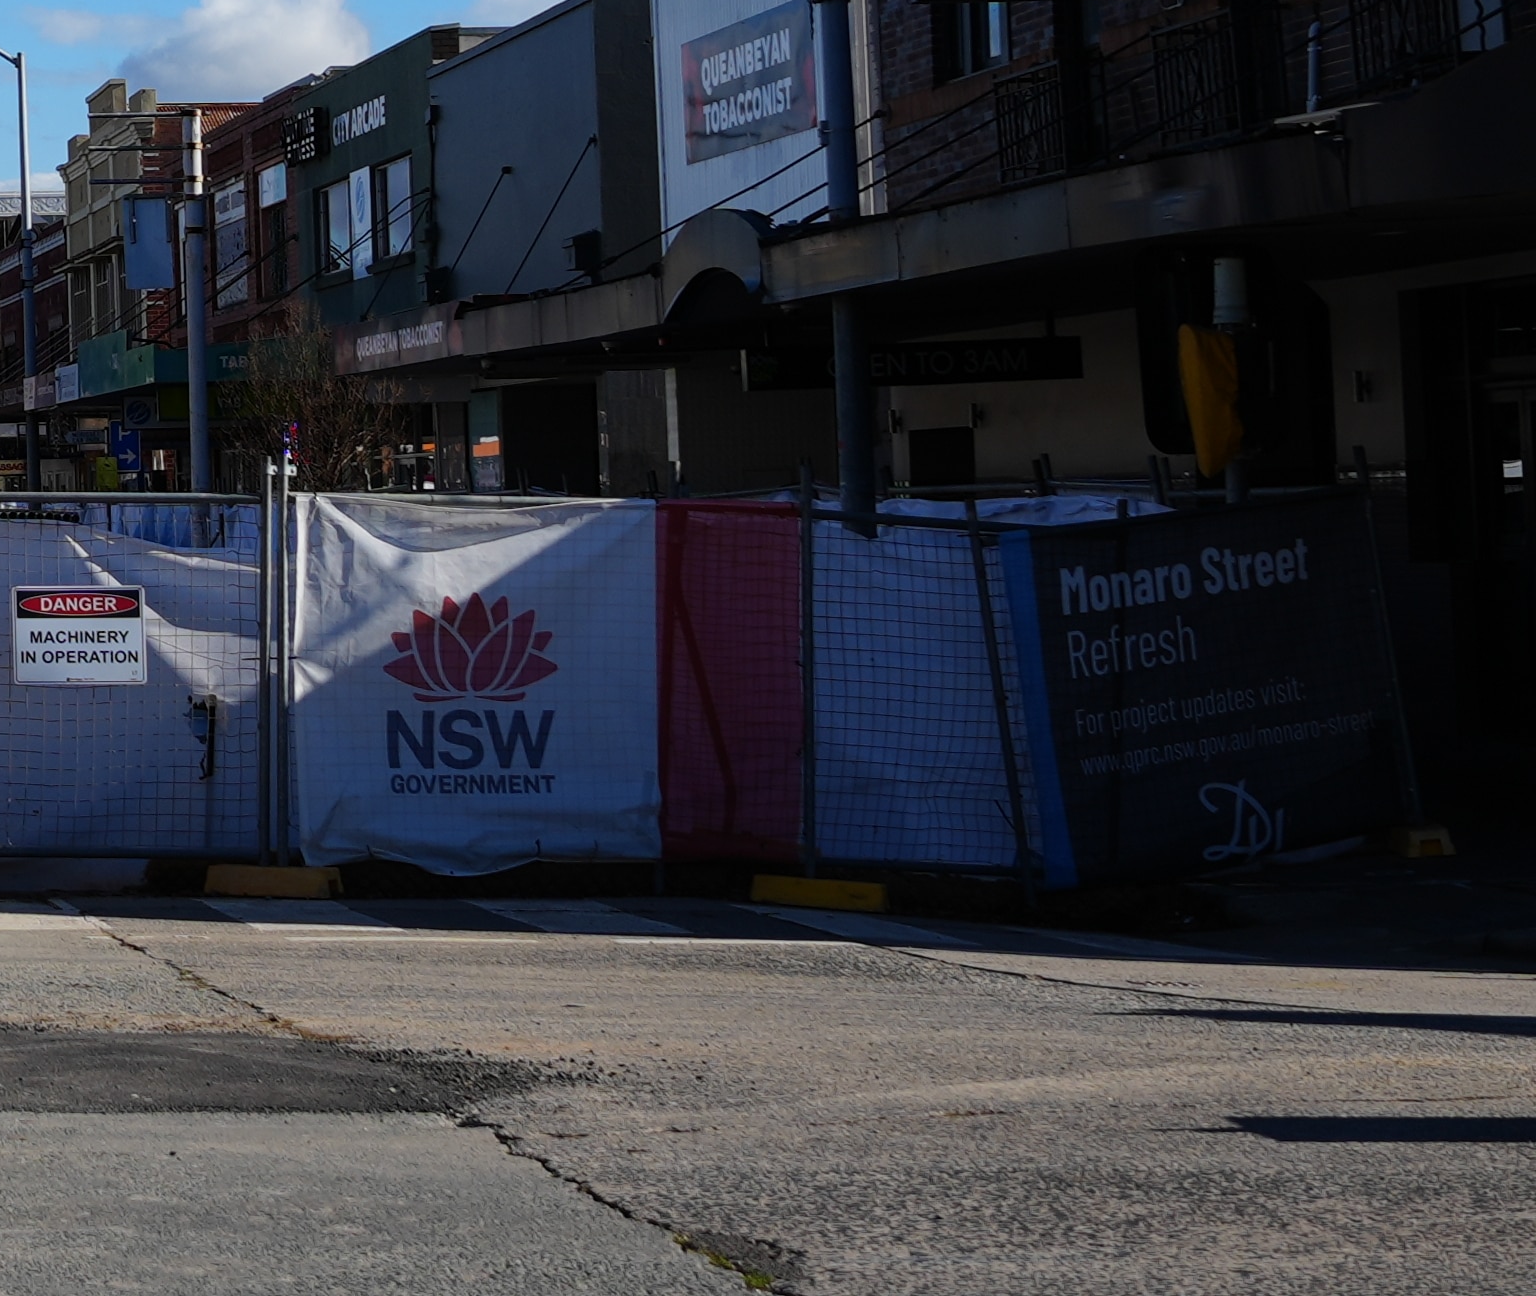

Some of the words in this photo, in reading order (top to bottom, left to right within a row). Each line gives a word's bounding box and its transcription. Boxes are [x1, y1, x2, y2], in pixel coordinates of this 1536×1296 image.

[701, 28, 791, 96] QUEANBEYAN
[332, 111, 350, 147] CITY
[350, 94, 386, 140] ARCADE
[702, 76, 792, 136] TOBACCONIST
[916, 351, 954, 376] TO
[961, 348, 1029, 375] 3AM
[39, 596, 118, 612] DANGER
[1059, 562, 1193, 616] Monaro
[1200, 537, 1309, 596] Street
[21, 650, 37, 664] IN
[41, 650, 139, 665] OPERATION
[29, 630, 130, 645] MACHINERY
[1066, 615, 1198, 680] Refresh
[1074, 707, 1105, 738] For
[1110, 695, 1177, 737] project
[1182, 686, 1256, 726] updates
[1261, 675, 1307, 707] visit:
[385, 708, 556, 770] NSW
[389, 773, 556, 795] GOVERNMENT
